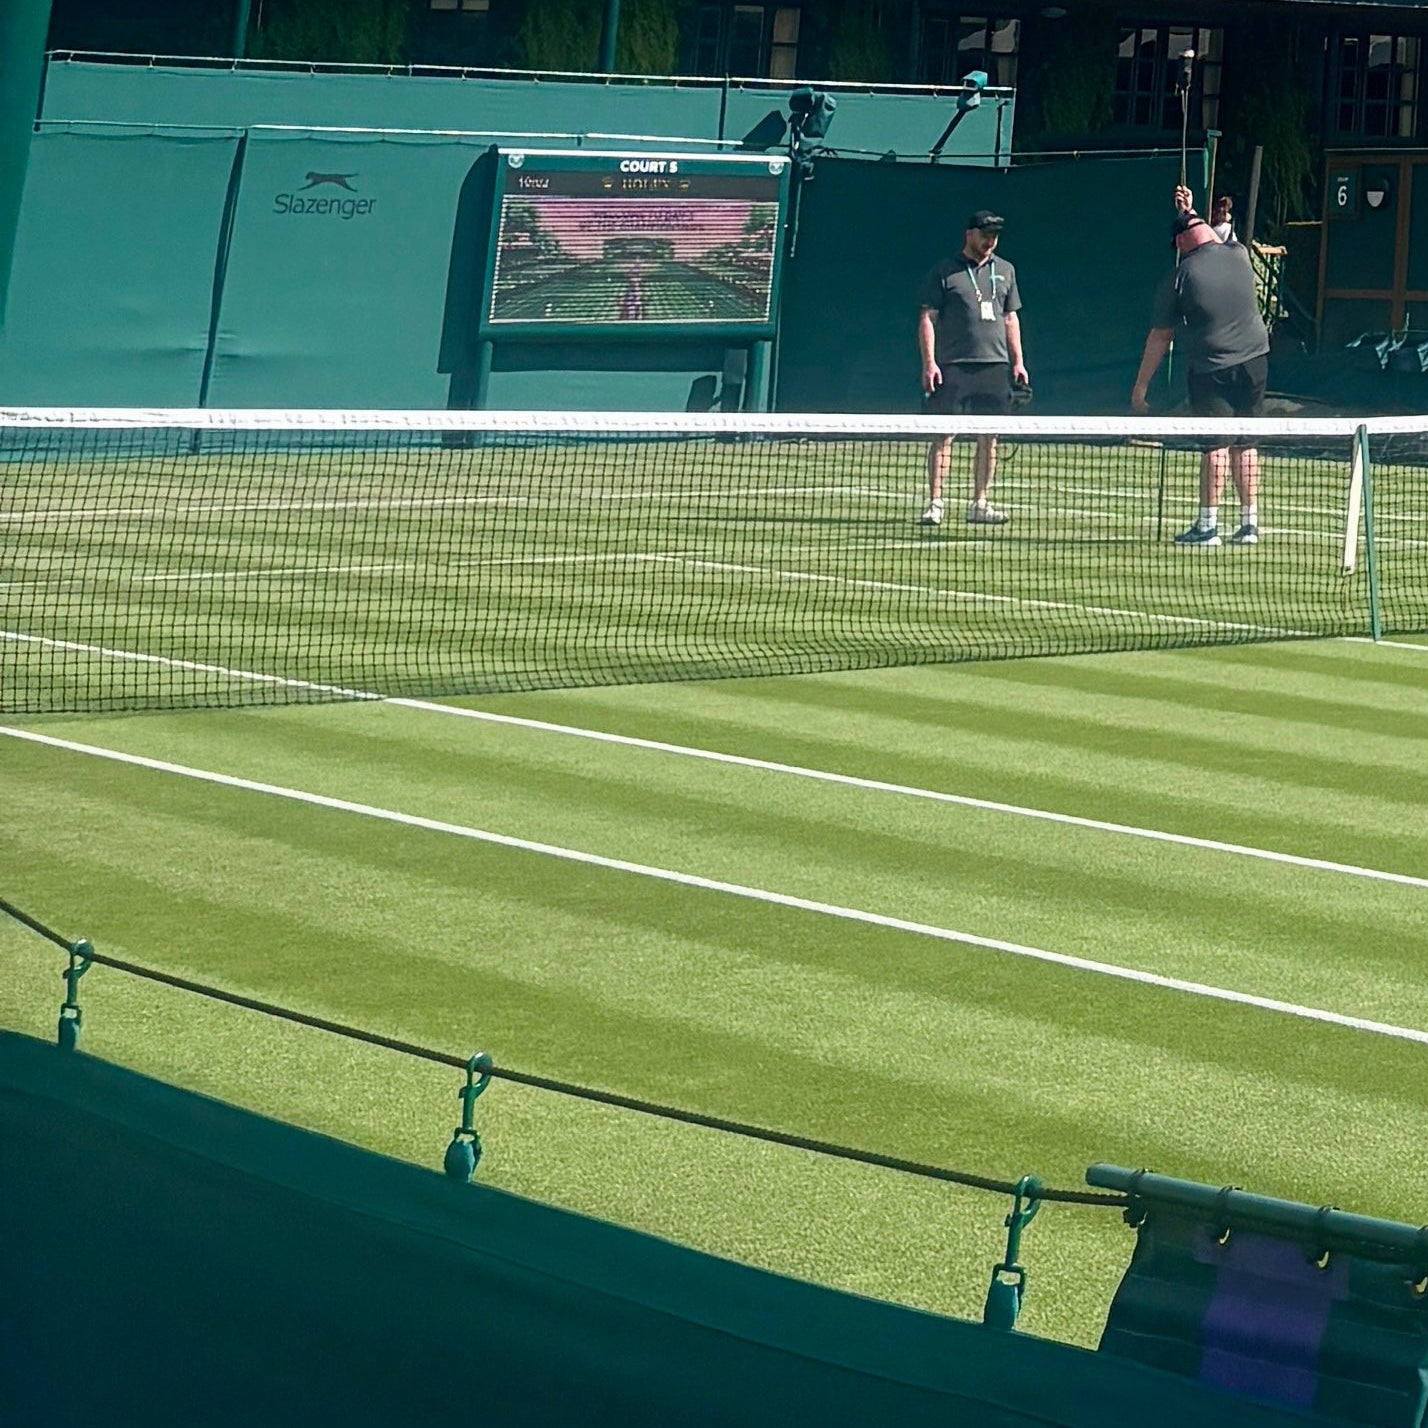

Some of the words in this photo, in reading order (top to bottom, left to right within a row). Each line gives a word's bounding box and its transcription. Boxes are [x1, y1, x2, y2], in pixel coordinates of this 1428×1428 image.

[620, 160, 667, 173] COURT
[1338, 185, 1348, 206] 6
[272, 194, 376, 220] Slazenger
